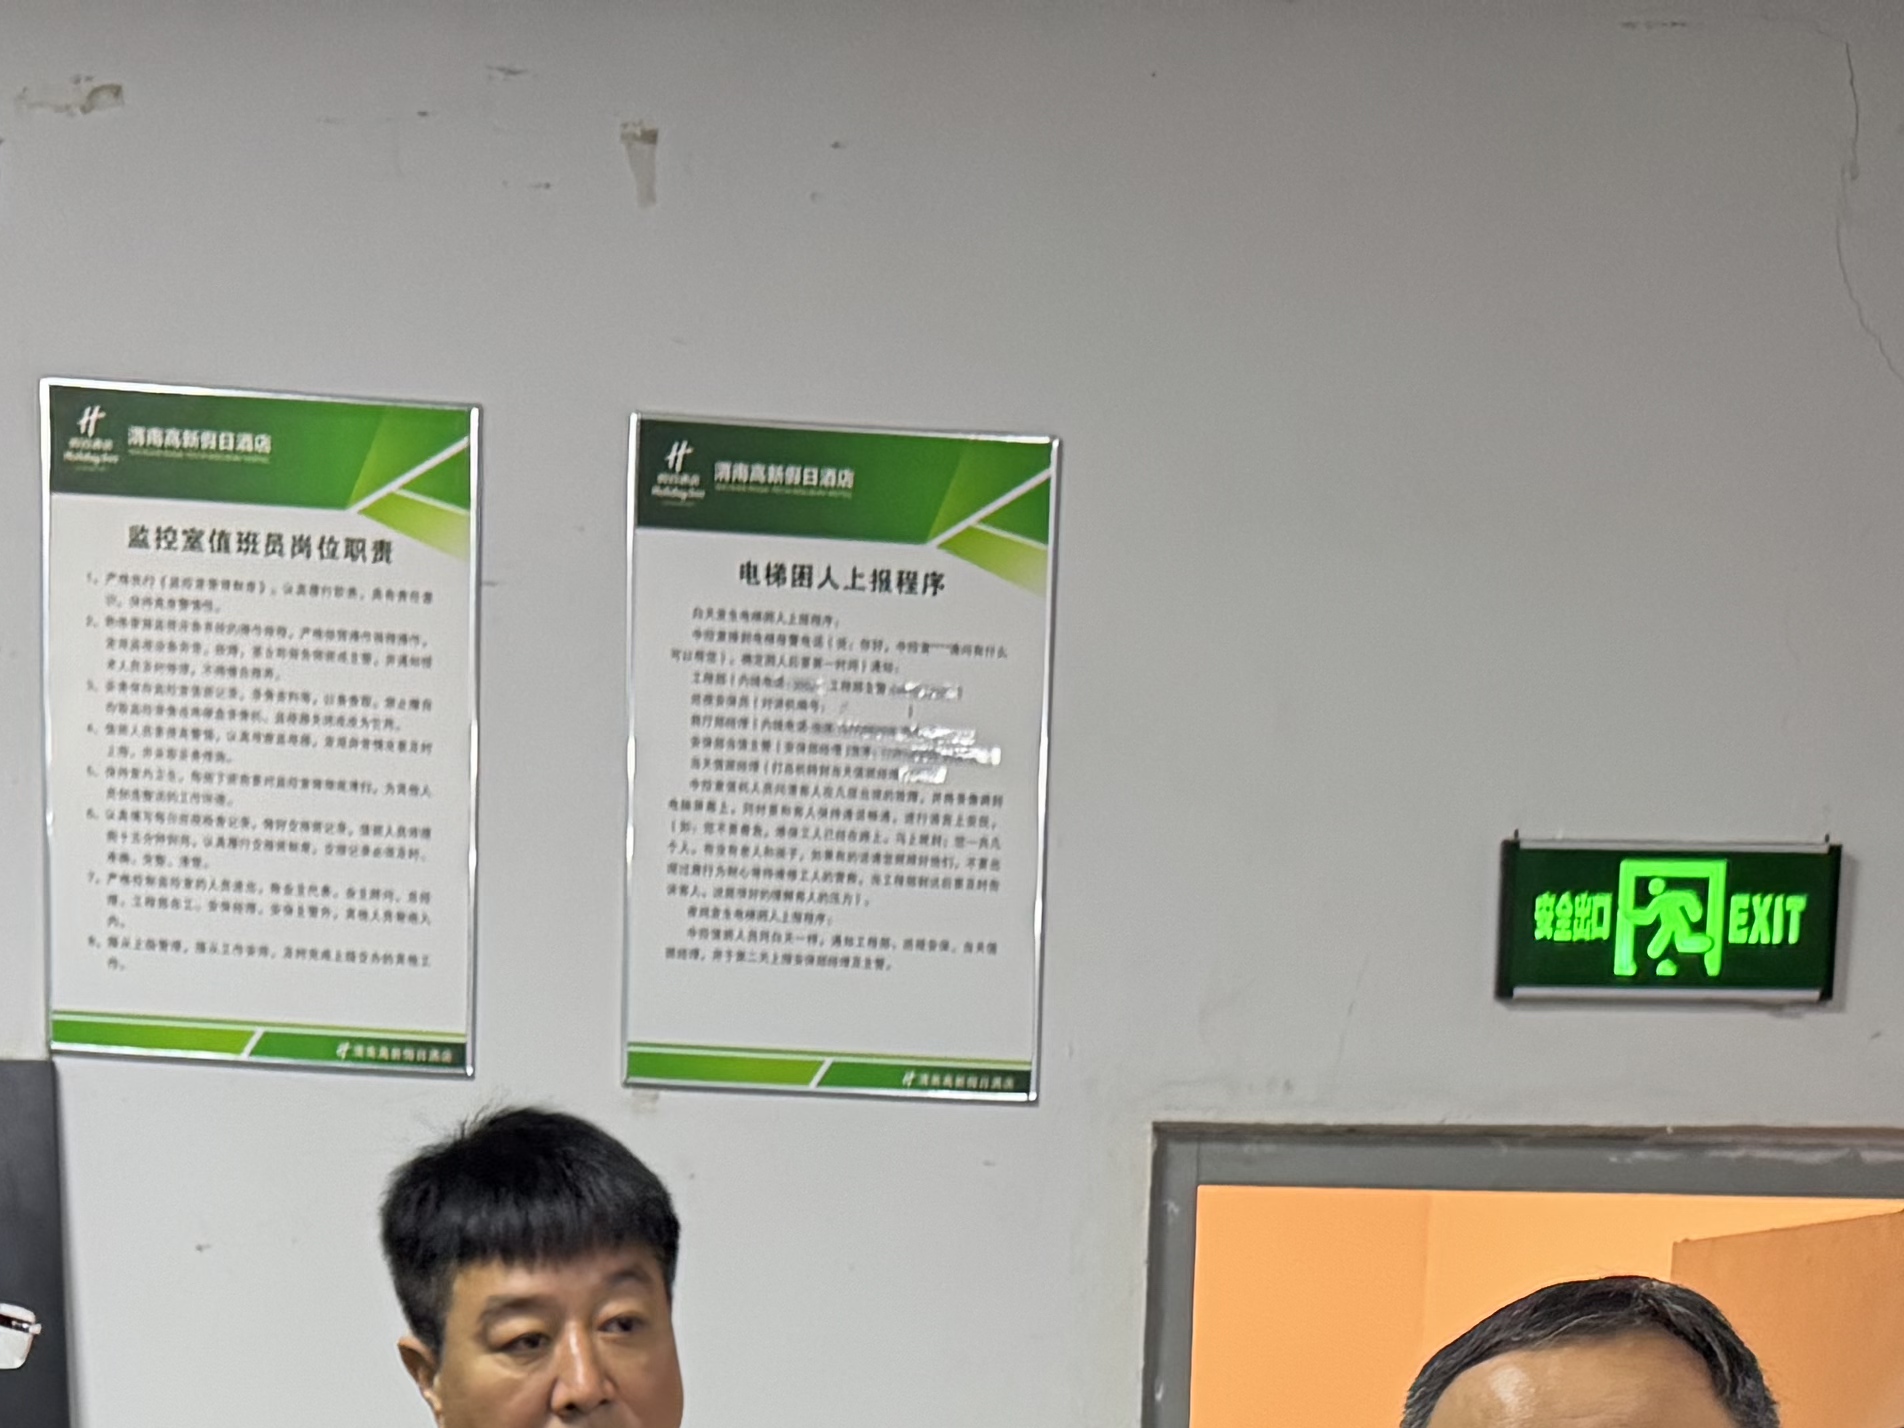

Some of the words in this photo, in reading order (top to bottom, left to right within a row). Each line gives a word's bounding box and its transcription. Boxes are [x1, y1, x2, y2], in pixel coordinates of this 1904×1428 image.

[128, 425, 272, 455] 渭南高新假日酒店
[714, 461, 855, 489] 渭南高新假日酒店
[128, 525, 394, 565] 监控室值班员岗位职责
[739, 560, 946, 597] 电梯困人上报程序
[1534, 890, 1613, 941] 安全出口
[1728, 893, 1808, 945] EXIT
